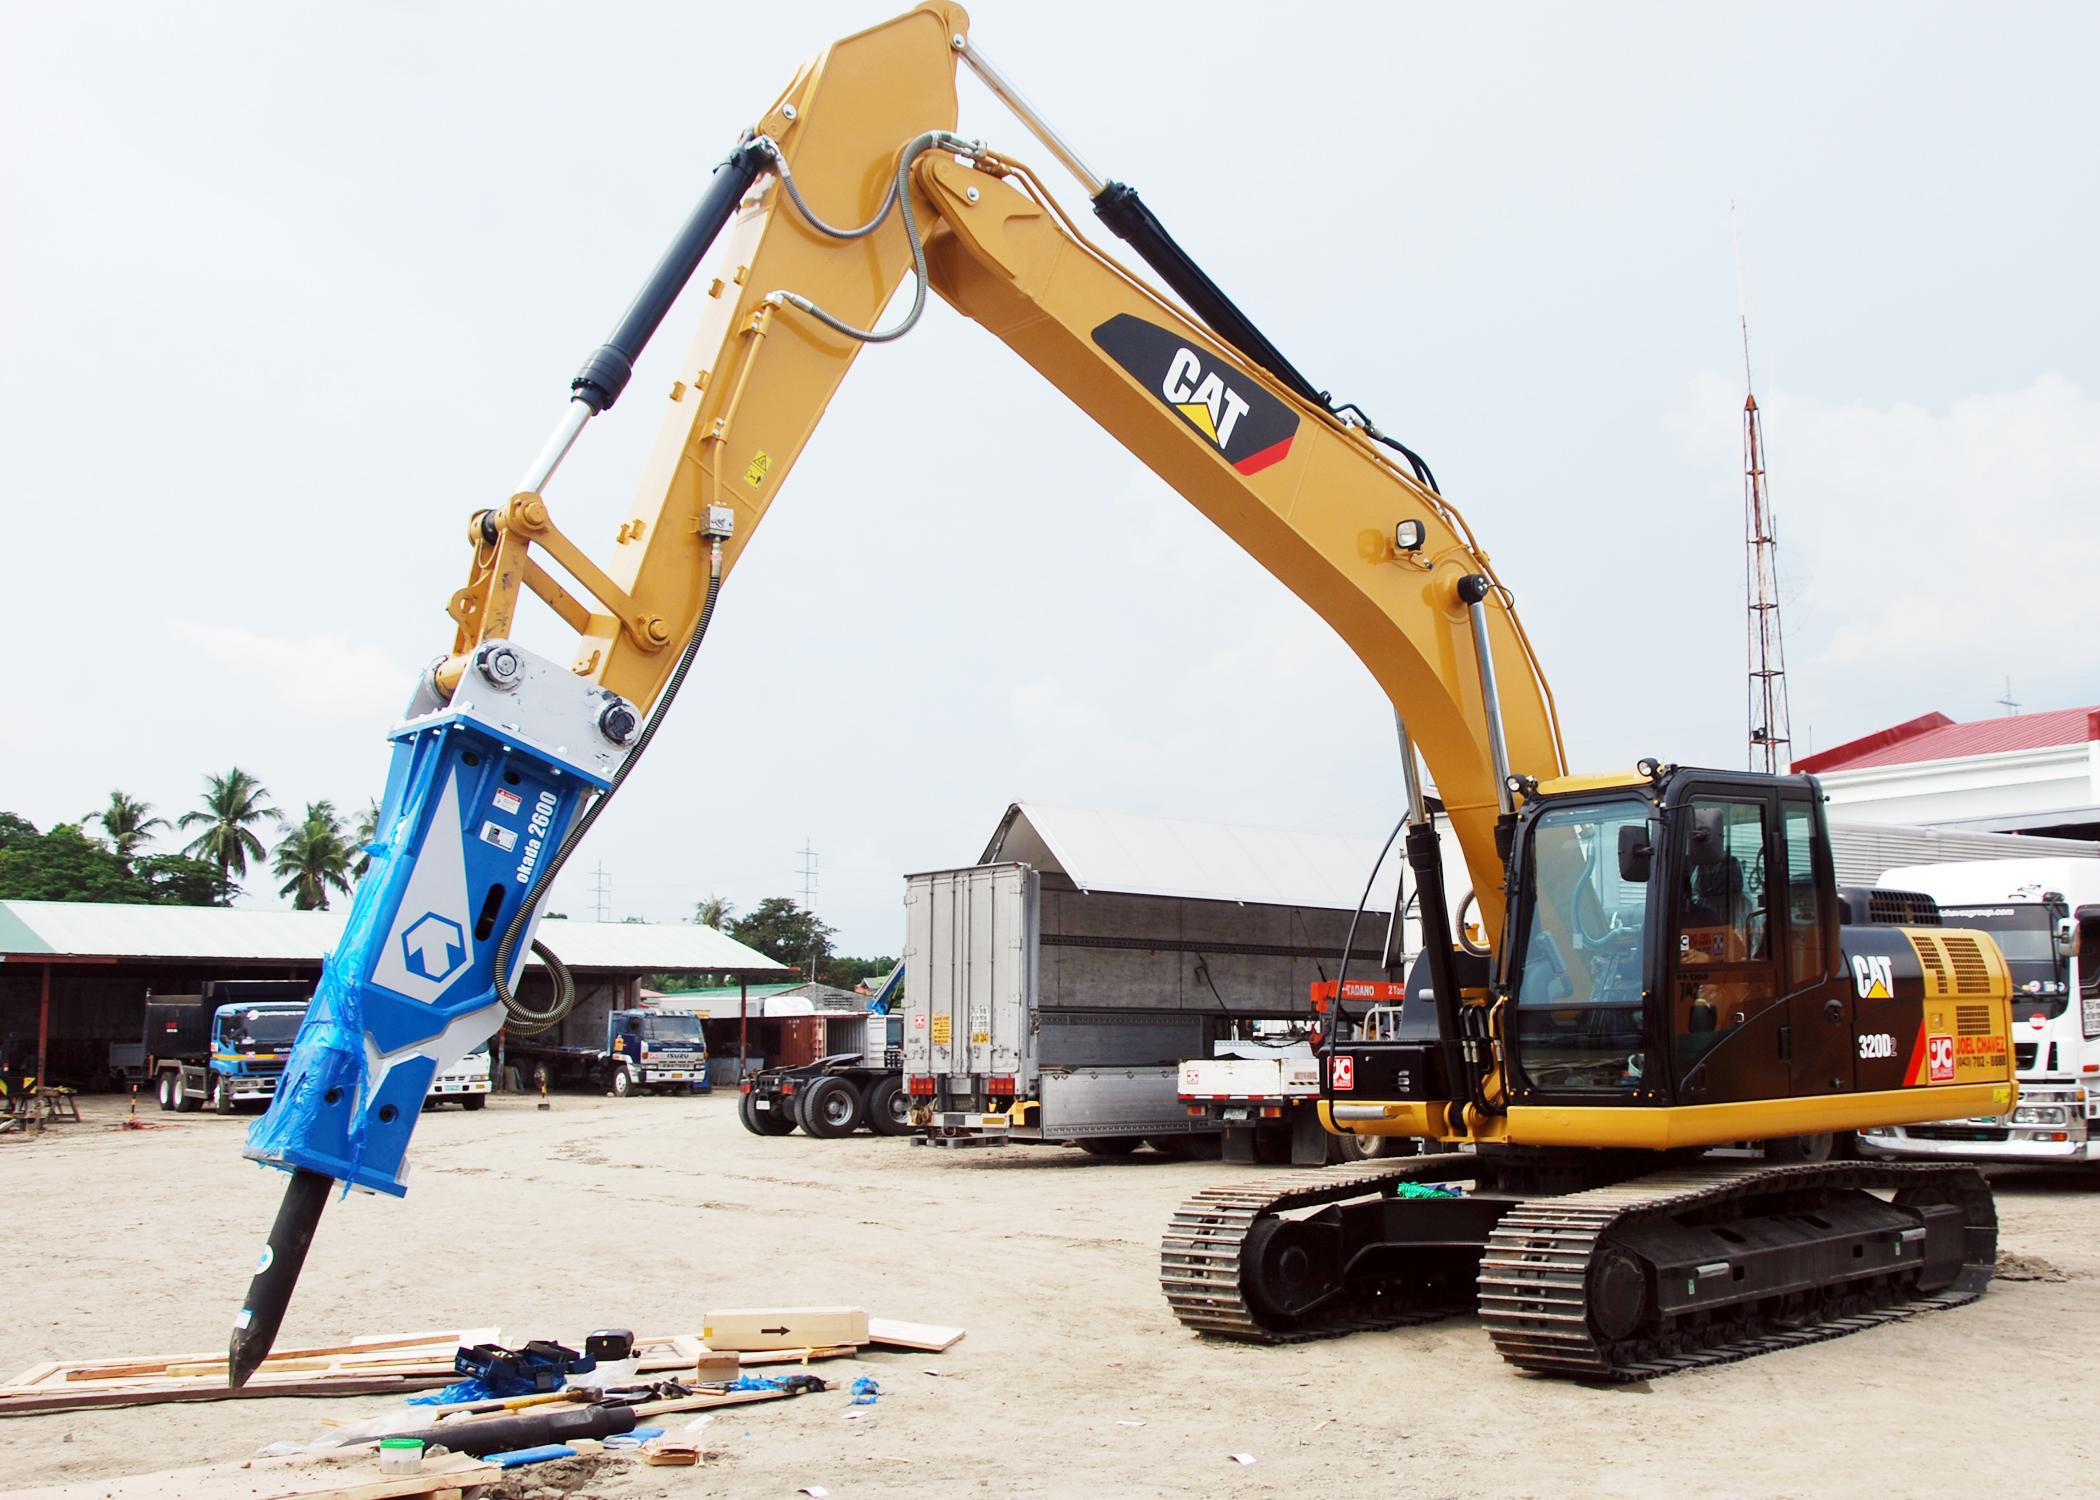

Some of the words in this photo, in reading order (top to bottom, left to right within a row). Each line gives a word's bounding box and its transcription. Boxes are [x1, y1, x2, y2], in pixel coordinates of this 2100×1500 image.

[1162, 347, 1250, 449] CAT
[527, 791, 557, 838] 2600
[516, 839, 541, 884] okada
[1345, 984, 1375, 996] TADANO
[1388, 985, 1393, 995] 2
[1852, 955, 1894, 998] CAT
[1957, 1036, 1975, 1054] JOEL
[1977, 1035, 2005, 1053] CHAVEZ
